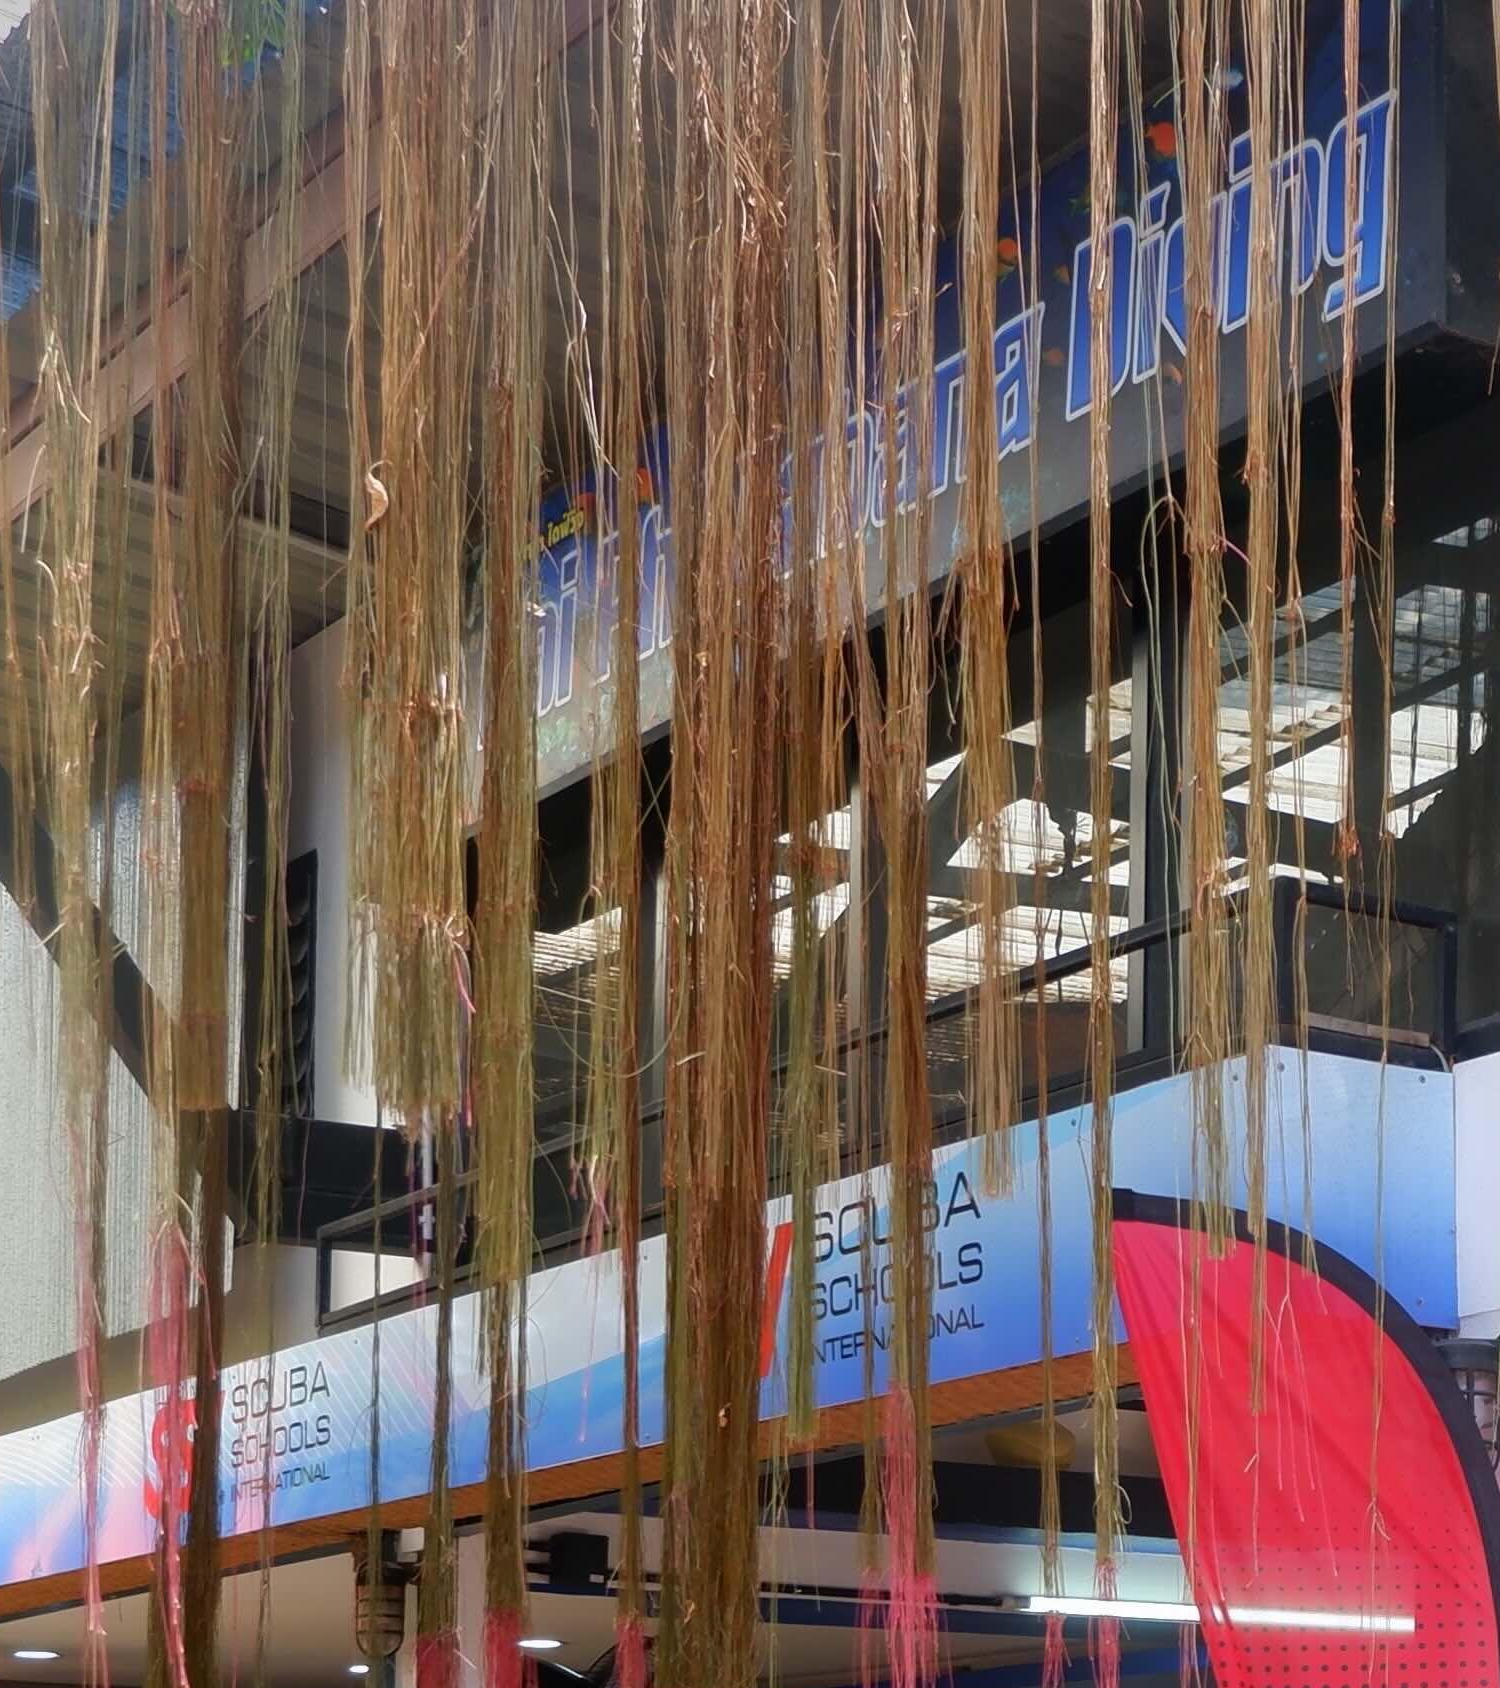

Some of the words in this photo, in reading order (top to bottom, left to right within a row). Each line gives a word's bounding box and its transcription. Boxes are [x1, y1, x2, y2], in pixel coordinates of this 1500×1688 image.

[231, 1361, 331, 1425] SCUBA
[231, 1414, 331, 1467] SCHOOLS
[231, 1463, 330, 1511] INTERNATIONAL
